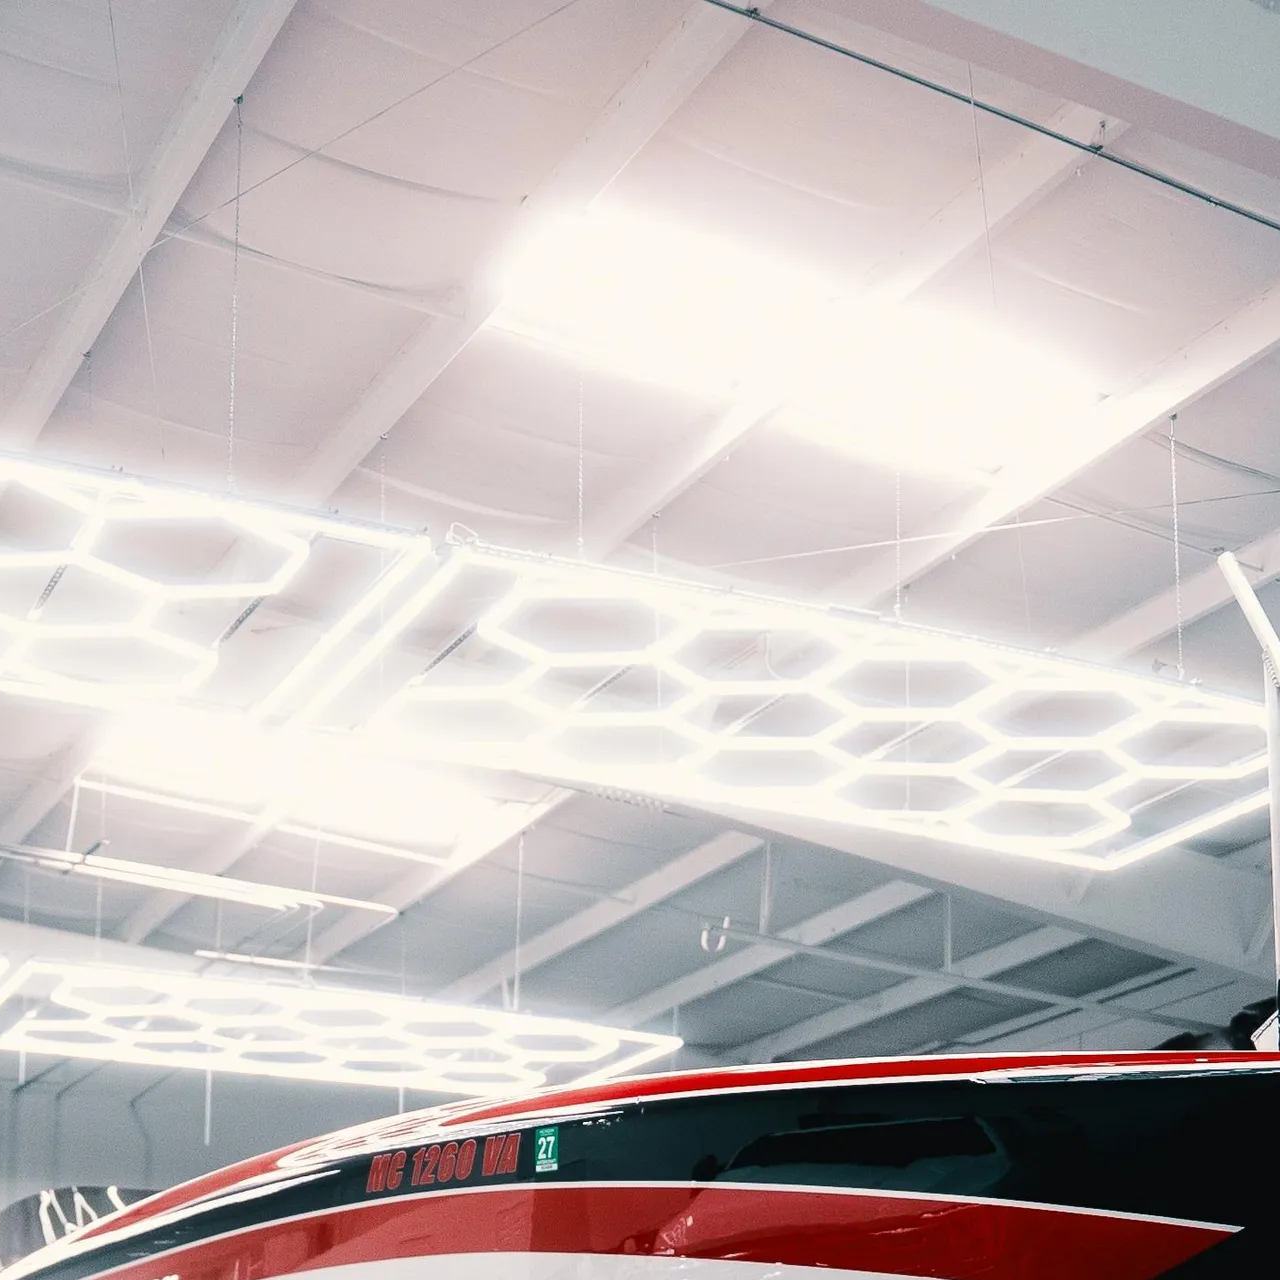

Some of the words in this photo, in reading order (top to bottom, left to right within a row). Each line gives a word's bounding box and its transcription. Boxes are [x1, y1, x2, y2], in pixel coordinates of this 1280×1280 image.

[366, 1151, 406, 1192] MC
[411, 1139, 477, 1186] 1260
[482, 1133, 521, 1176] VA
[538, 1136, 555, 1160] 27
